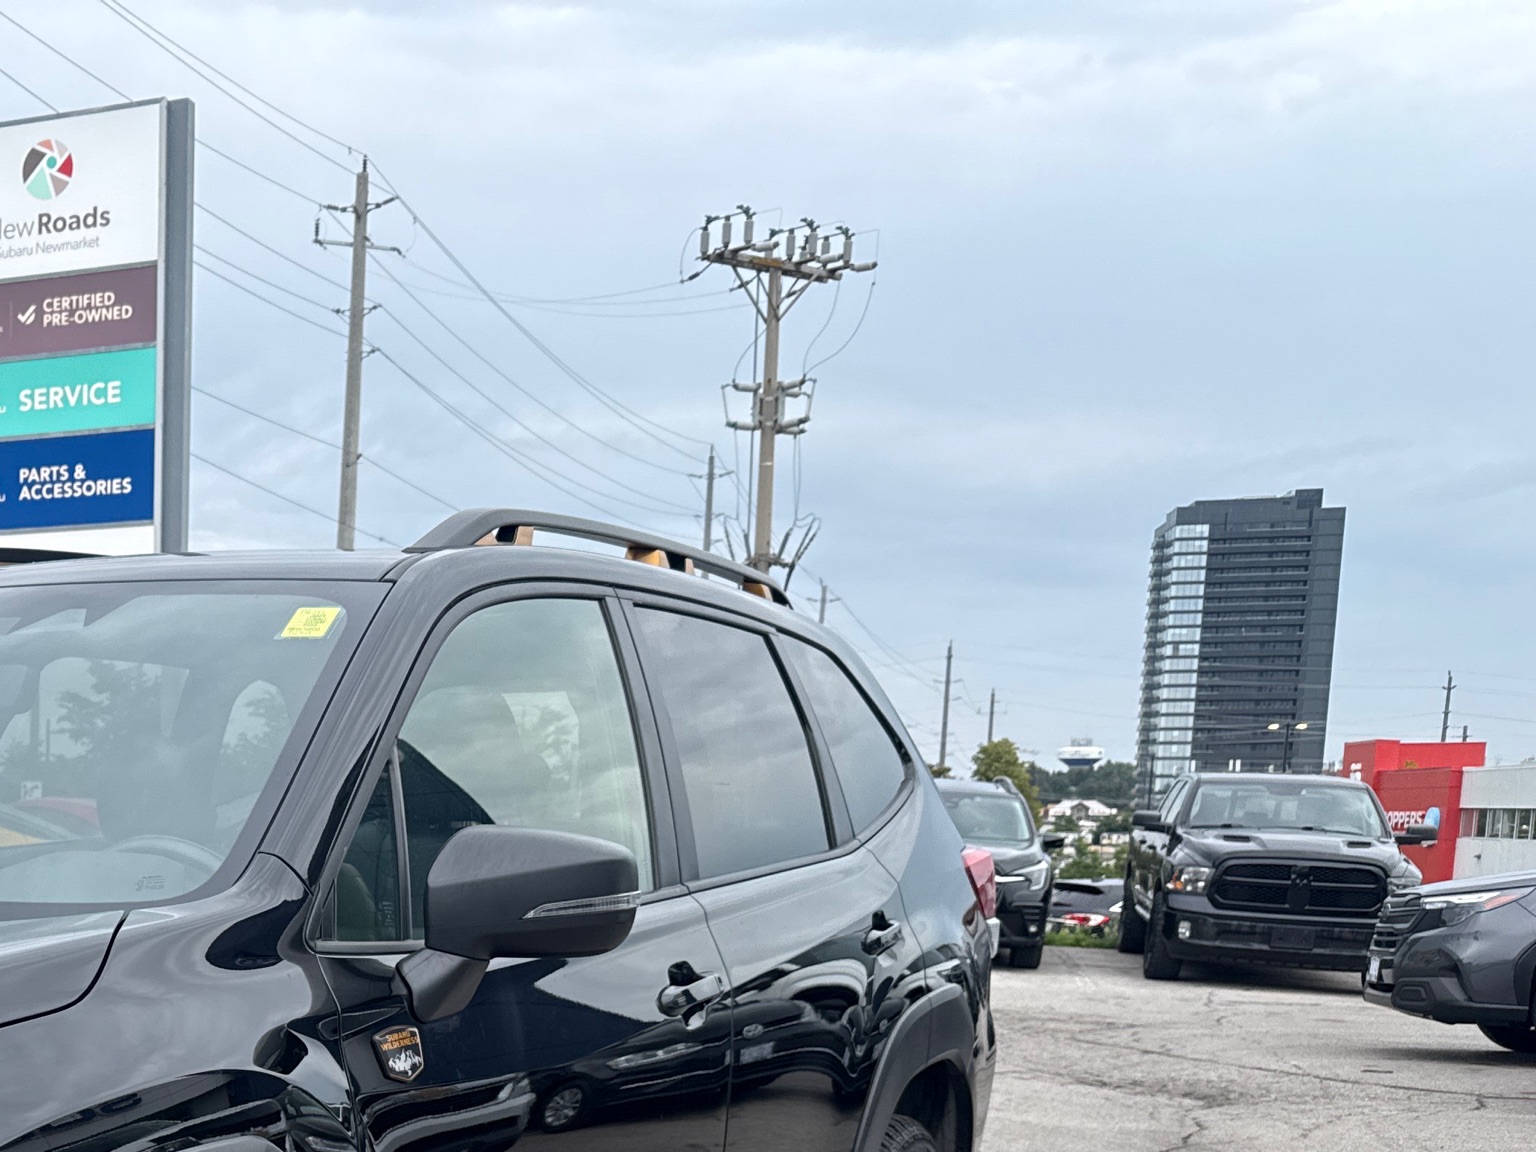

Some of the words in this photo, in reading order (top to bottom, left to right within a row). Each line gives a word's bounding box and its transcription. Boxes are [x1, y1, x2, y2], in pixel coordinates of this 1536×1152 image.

[35, 236, 100, 255] Newmarket
[42, 292, 115, 313] CERTIFIED
[42, 305, 133, 328] PRE-OWNED
[19, 381, 122, 412] SERVICE
[19, 464, 69, 484] PARTS
[73, 463, 87, 480] &
[18, 477, 133, 501] ACCESSORIES
[1386, 810, 1424, 829] OPPERS
[380, 1036, 420, 1051] WILDERNESS
[386, 1031, 411, 1042] SUBARU
